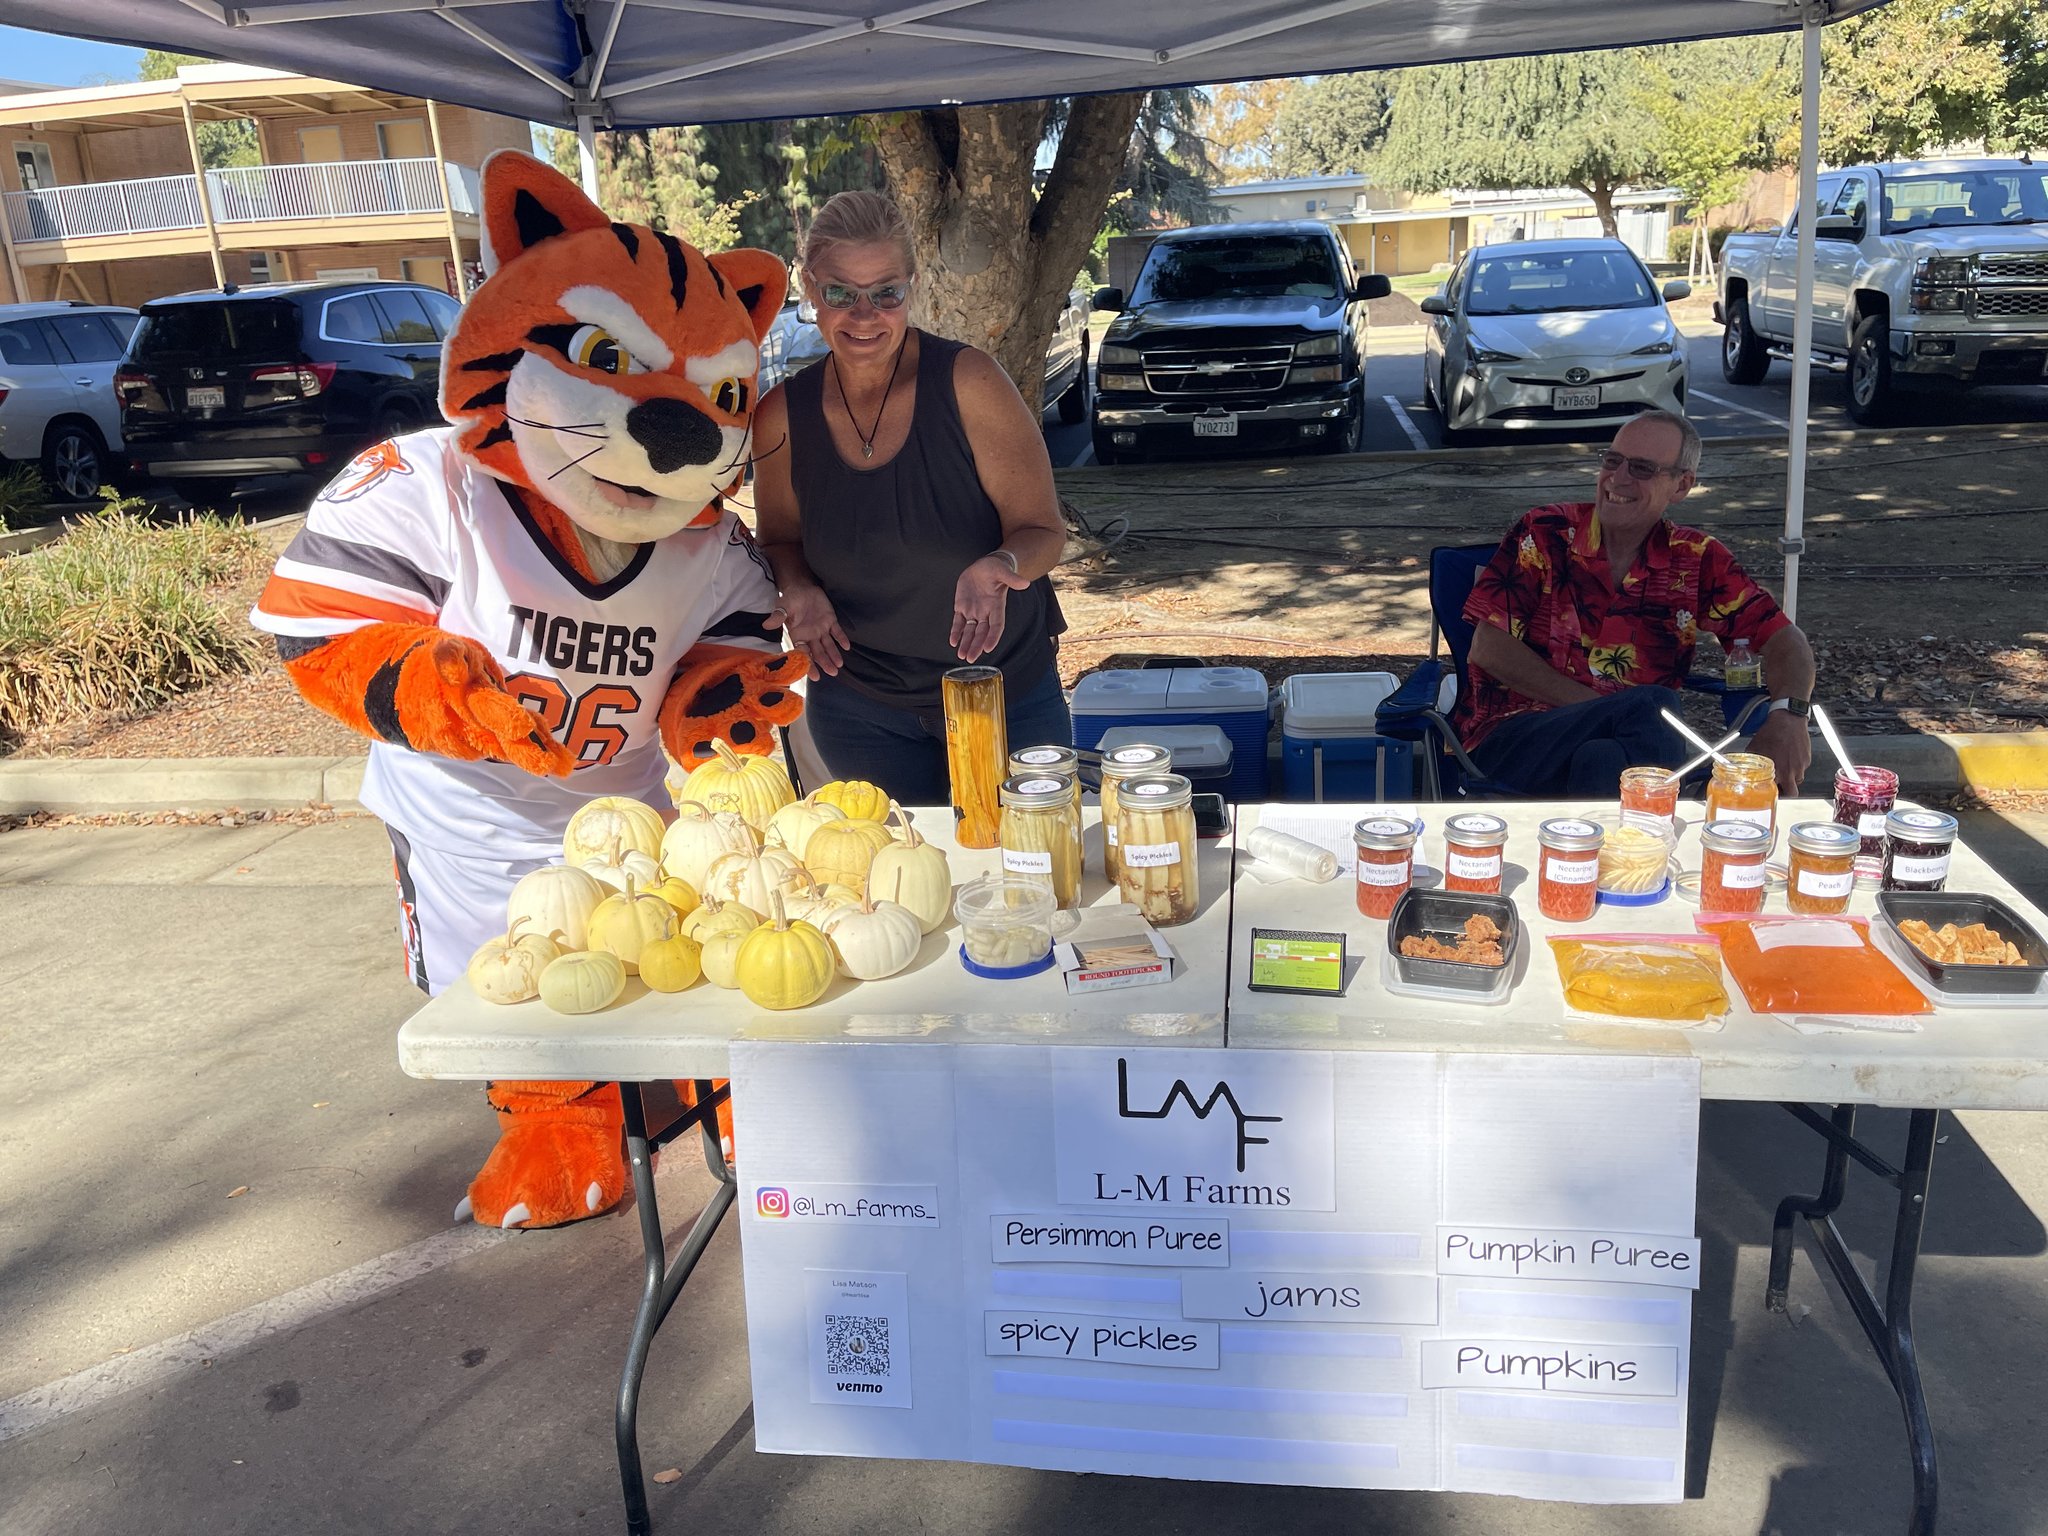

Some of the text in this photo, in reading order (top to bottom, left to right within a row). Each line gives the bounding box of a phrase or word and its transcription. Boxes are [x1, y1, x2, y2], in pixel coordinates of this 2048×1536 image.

[507, 604, 656, 677] TIGERS
[1006, 857, 1021, 866] Spicy
[1458, 859, 1493, 868] Nectarine
[1366, 866, 1399, 875] Nectarine
[1461, 869, 1490, 877] (Vanilla)
[1558, 865, 1592, 873] Nectarine
[1818, 881, 1841, 889] Peach
[1112, 966, 1158, 978] TOOTHPICKS
[1093, 1173, 1291, 1206] L-M Farms
[1006, 1221, 1222, 1250] Persimmon Puree
[1447, 1234, 1691, 1274] Pumpkin Puree
[832, 1280, 877, 1289] Lisa Matson
[1244, 1281, 1361, 1318] jams
[999, 1319, 1198, 1357] spicy pickles
[1457, 1346, 1637, 1390] Pumpkins
[836, 1382, 883, 1393] venmo
